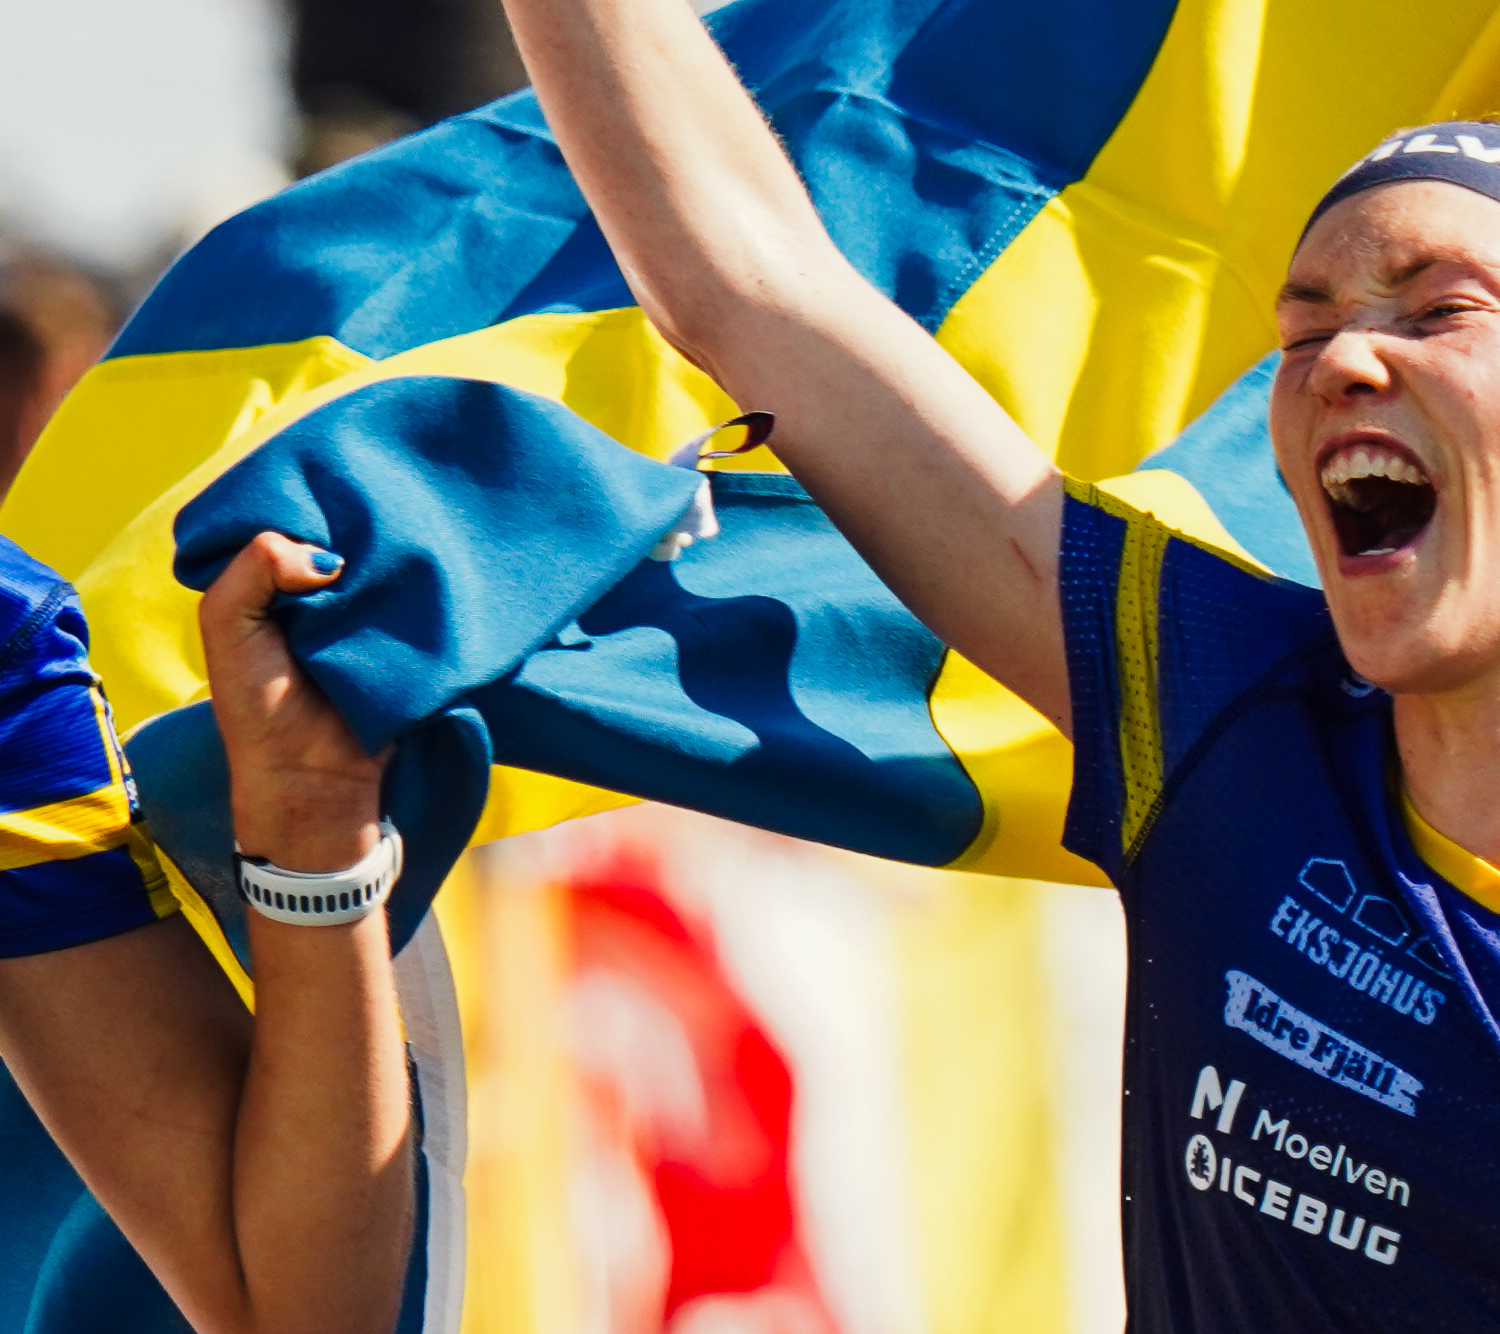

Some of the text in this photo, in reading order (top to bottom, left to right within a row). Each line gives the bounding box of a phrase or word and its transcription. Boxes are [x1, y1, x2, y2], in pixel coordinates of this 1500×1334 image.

[1268, 894, 1447, 1026] EKSJÖHUS
[1243, 987, 1398, 1095] Idre Fjäll
[1219, 1157, 1402, 1266] ICEBUG
[1250, 1108, 1411, 1208] Moelven
